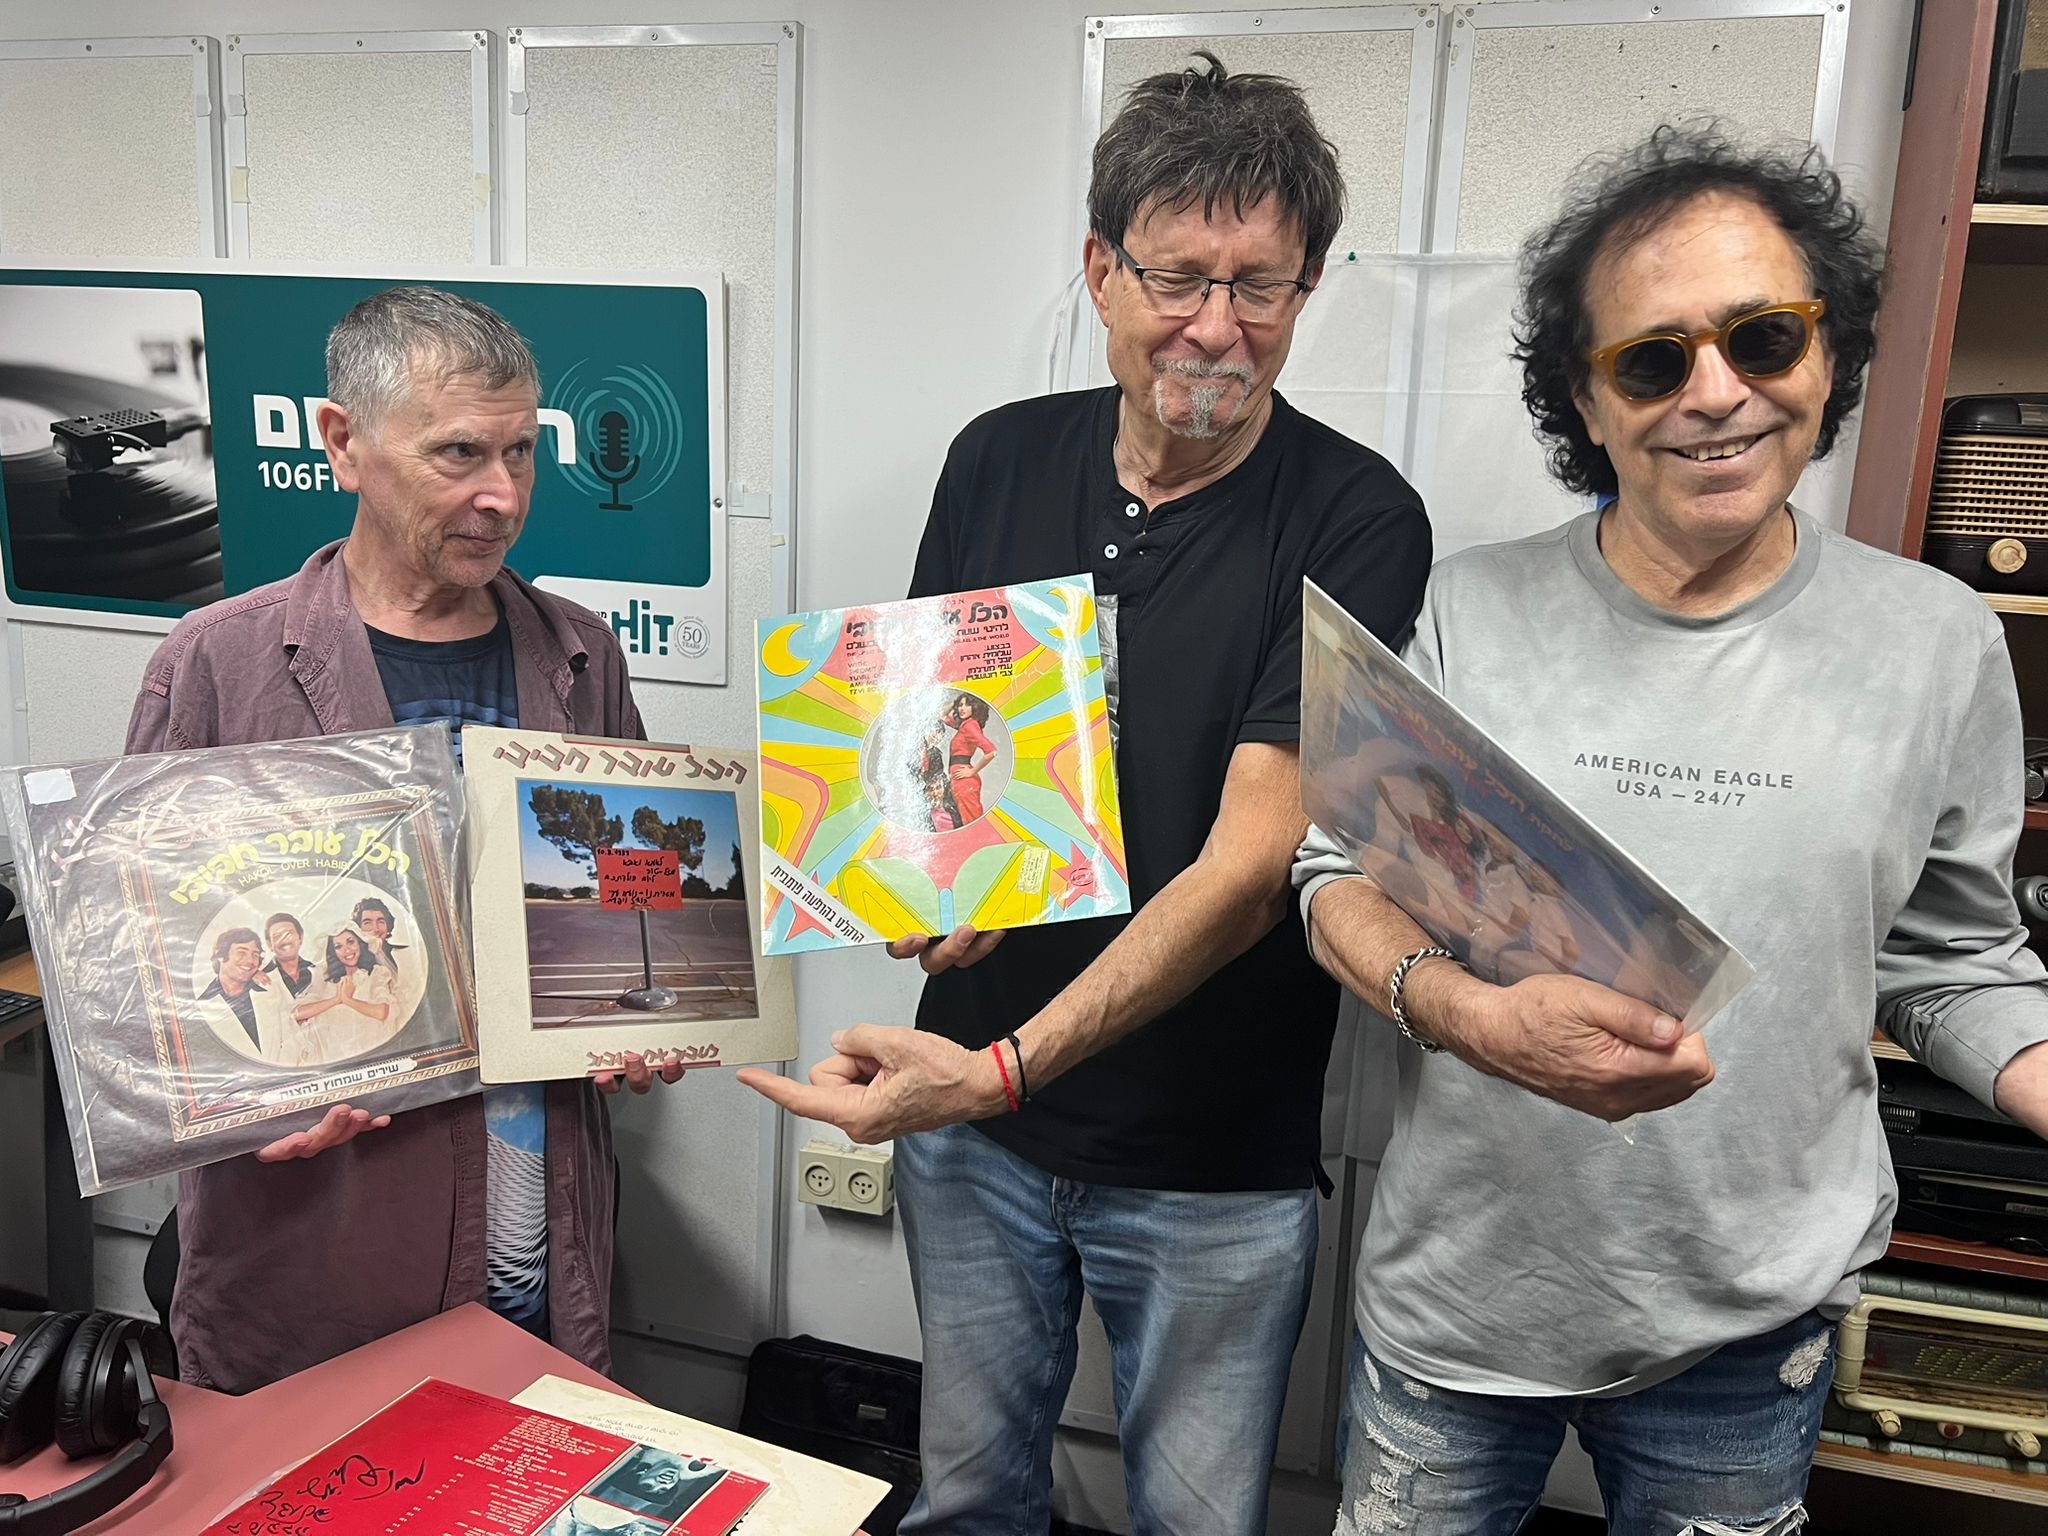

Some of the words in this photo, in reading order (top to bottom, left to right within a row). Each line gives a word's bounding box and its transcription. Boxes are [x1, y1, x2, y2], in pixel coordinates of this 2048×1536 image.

[257, 461, 340, 492] 106F
[967, 602, 1008, 624] הכל
[682, 626, 702, 644] 50
[492, 740, 591, 773] חביבי
[598, 749, 676, 778] עובר
[684, 754, 748, 785] הכל
[1573, 753, 1702, 782] AMERICAN
[1713, 769, 1794, 789] EAGLE
[1616, 779, 1662, 799] USA
[1693, 789, 1746, 807] 24/7
[264, 829, 346, 855] עובר
[351, 828, 410, 874] הכל
[168, 842, 261, 905] חביבי
[237, 866, 275, 887] HAKOL
[280, 859, 311, 872] OVER
[770, 865, 805, 895] פומבית
[801, 890, 837, 922] בהופעה
[834, 916, 866, 944] הוקלט
[367, 1063, 400, 1079] שירים
[586, 1050, 637, 1066] גבול
[323, 1072, 363, 1091] שמחוץ
